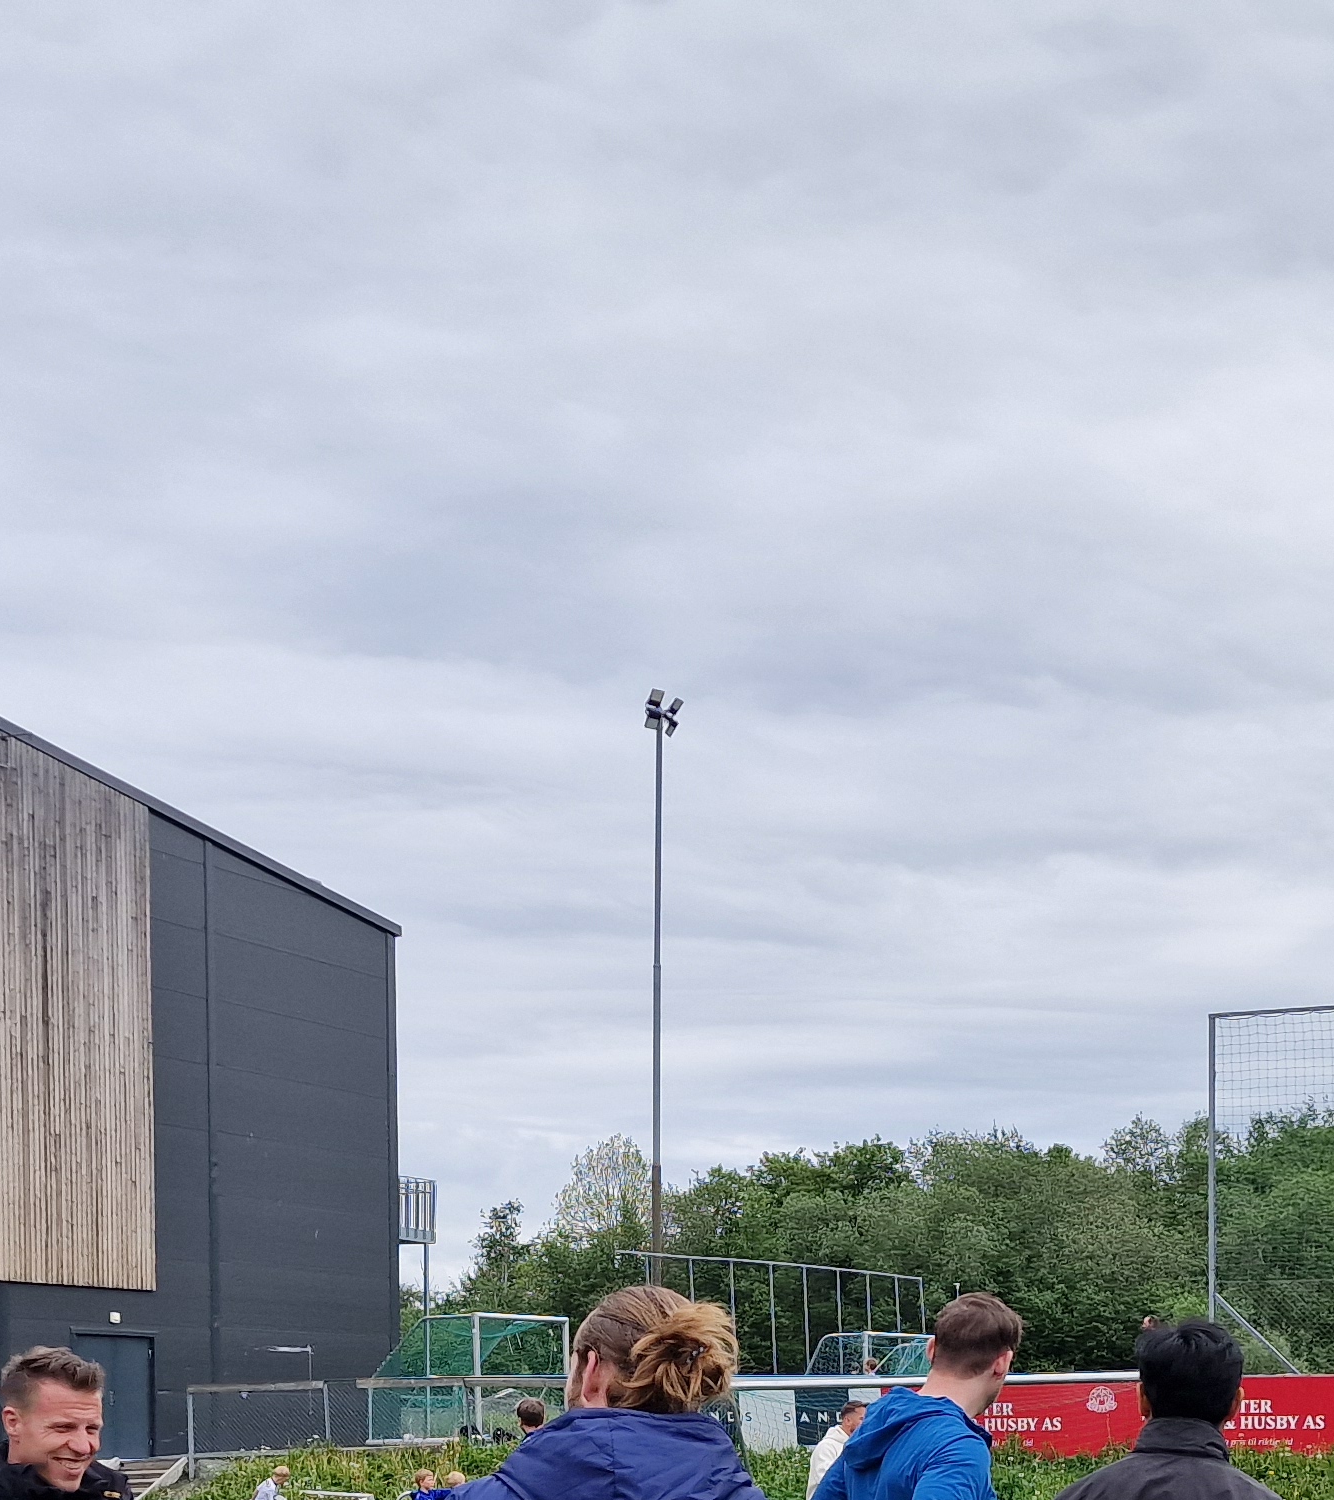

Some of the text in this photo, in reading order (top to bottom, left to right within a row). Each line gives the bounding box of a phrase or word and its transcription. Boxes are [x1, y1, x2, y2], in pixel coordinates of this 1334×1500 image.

[1240, 1399, 1273, 1414] TER
[984, 1416, 1062, 1432] HUSBY AS
[1240, 1415, 1299, 1430] HUSBY
[1302, 1415, 1326, 1430] AS
